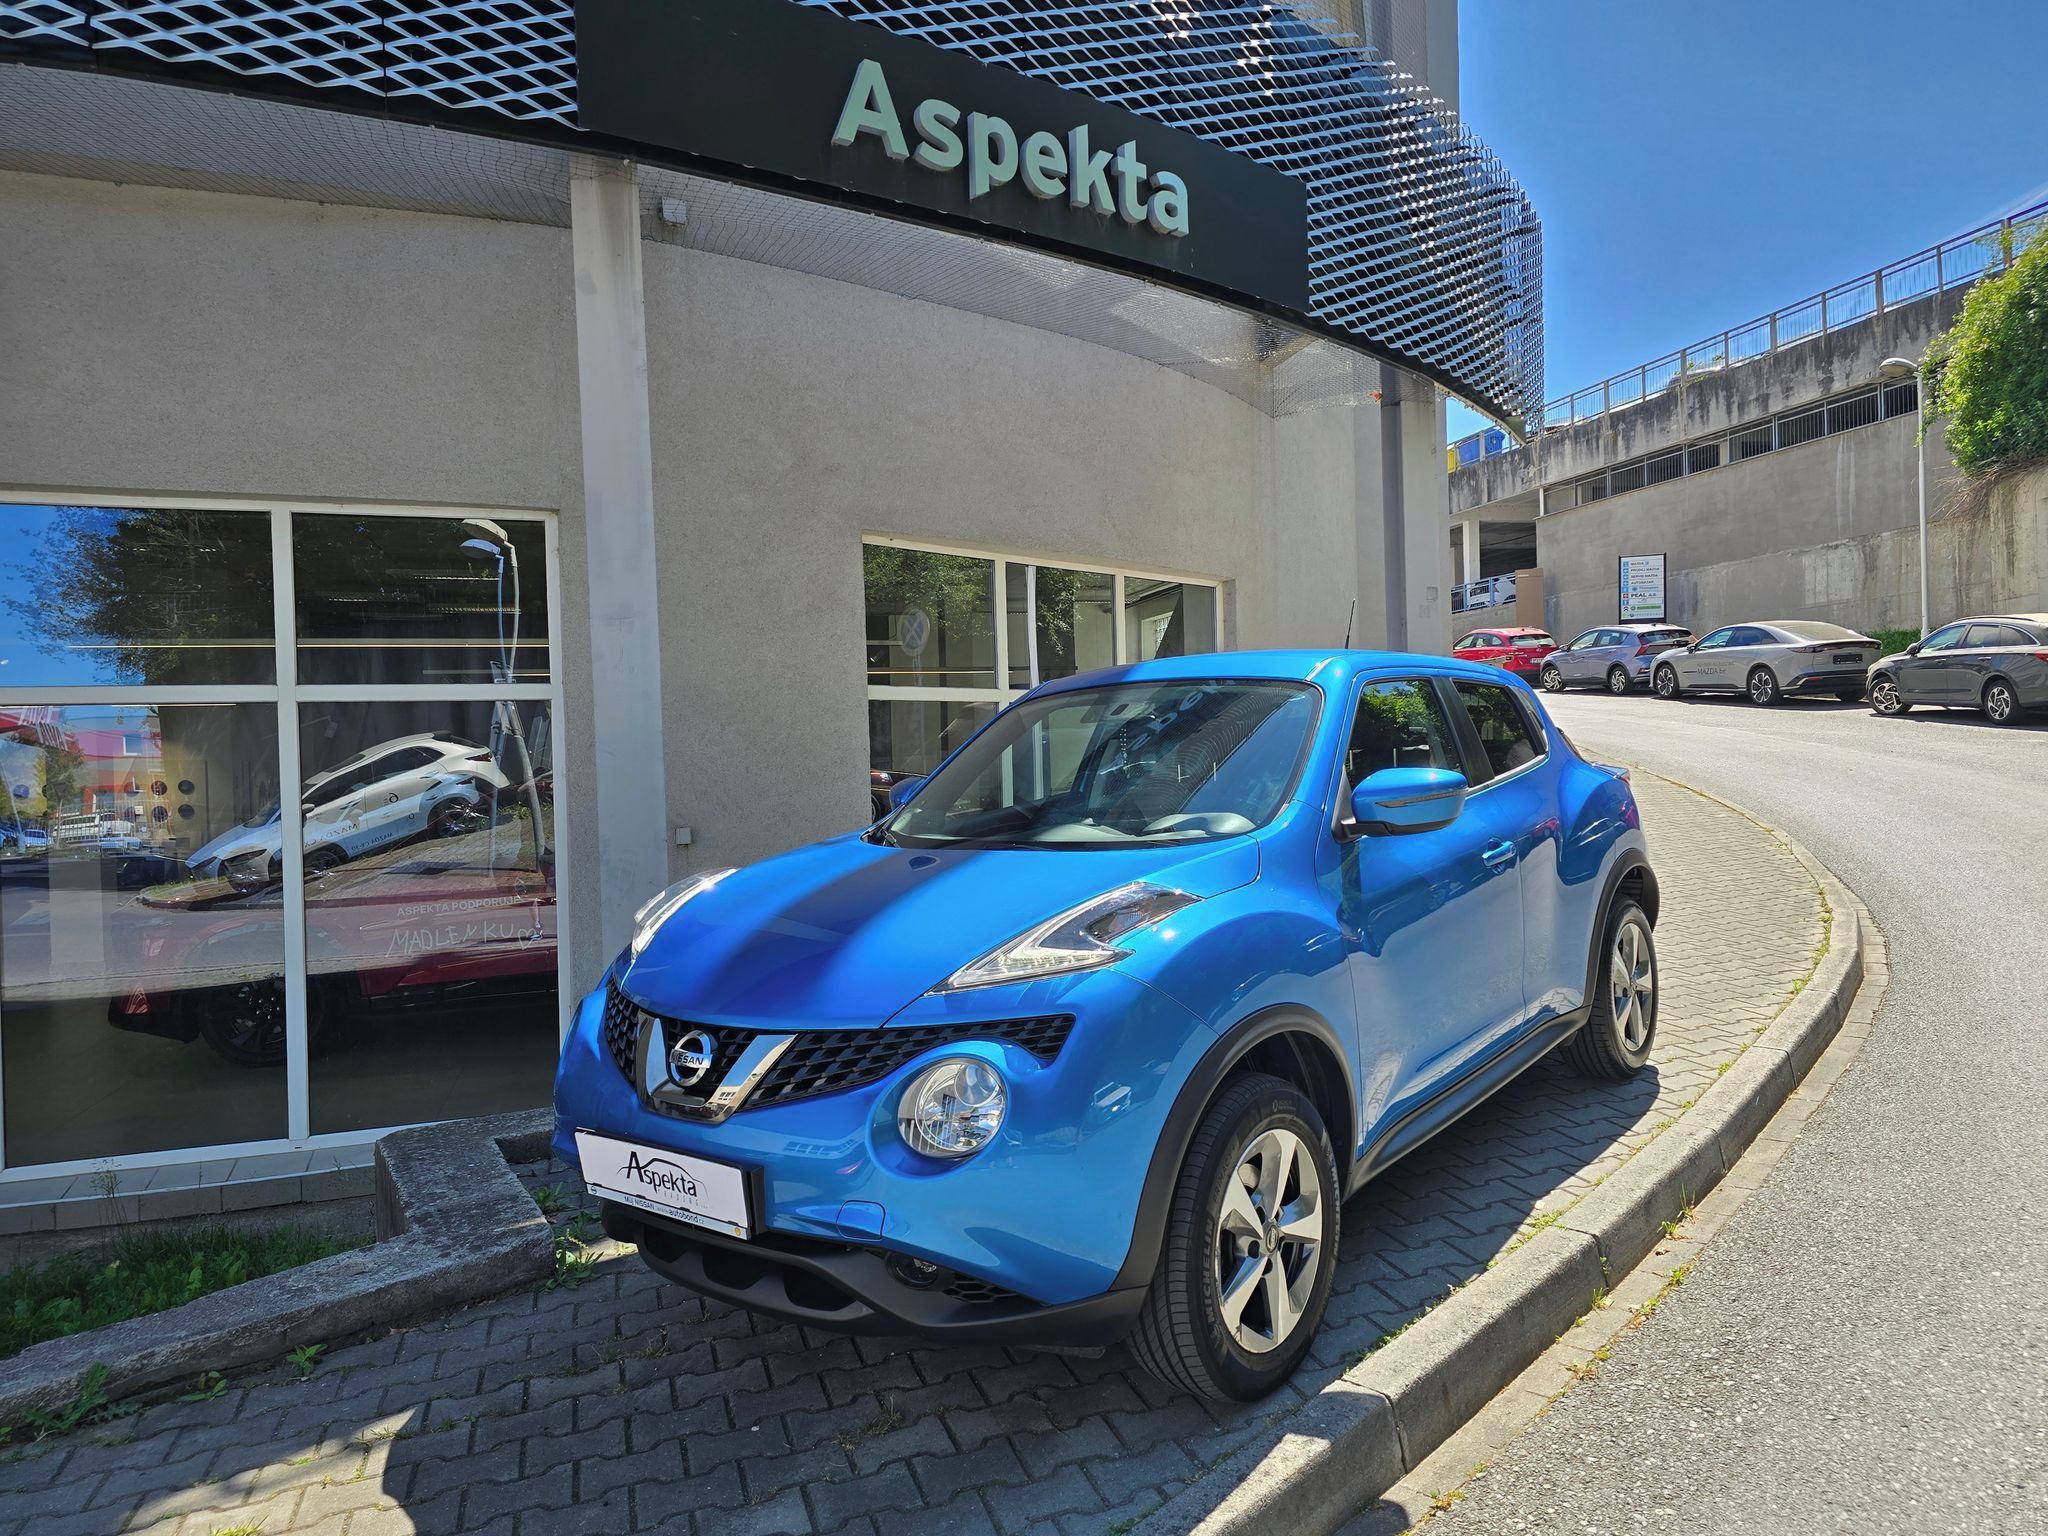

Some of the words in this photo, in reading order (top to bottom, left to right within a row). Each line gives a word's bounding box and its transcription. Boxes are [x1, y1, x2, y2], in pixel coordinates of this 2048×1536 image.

[831, 58, 1189, 237] Aspekta
[397, 903, 449, 917] ASPEKTA
[386, 920, 514, 958] MADLENKU
[626, 1151, 698, 1197] Aspekta
[634, 1198, 655, 1210] NISSAN
[1202, 1218, 1215, 1323] MICHELIN
